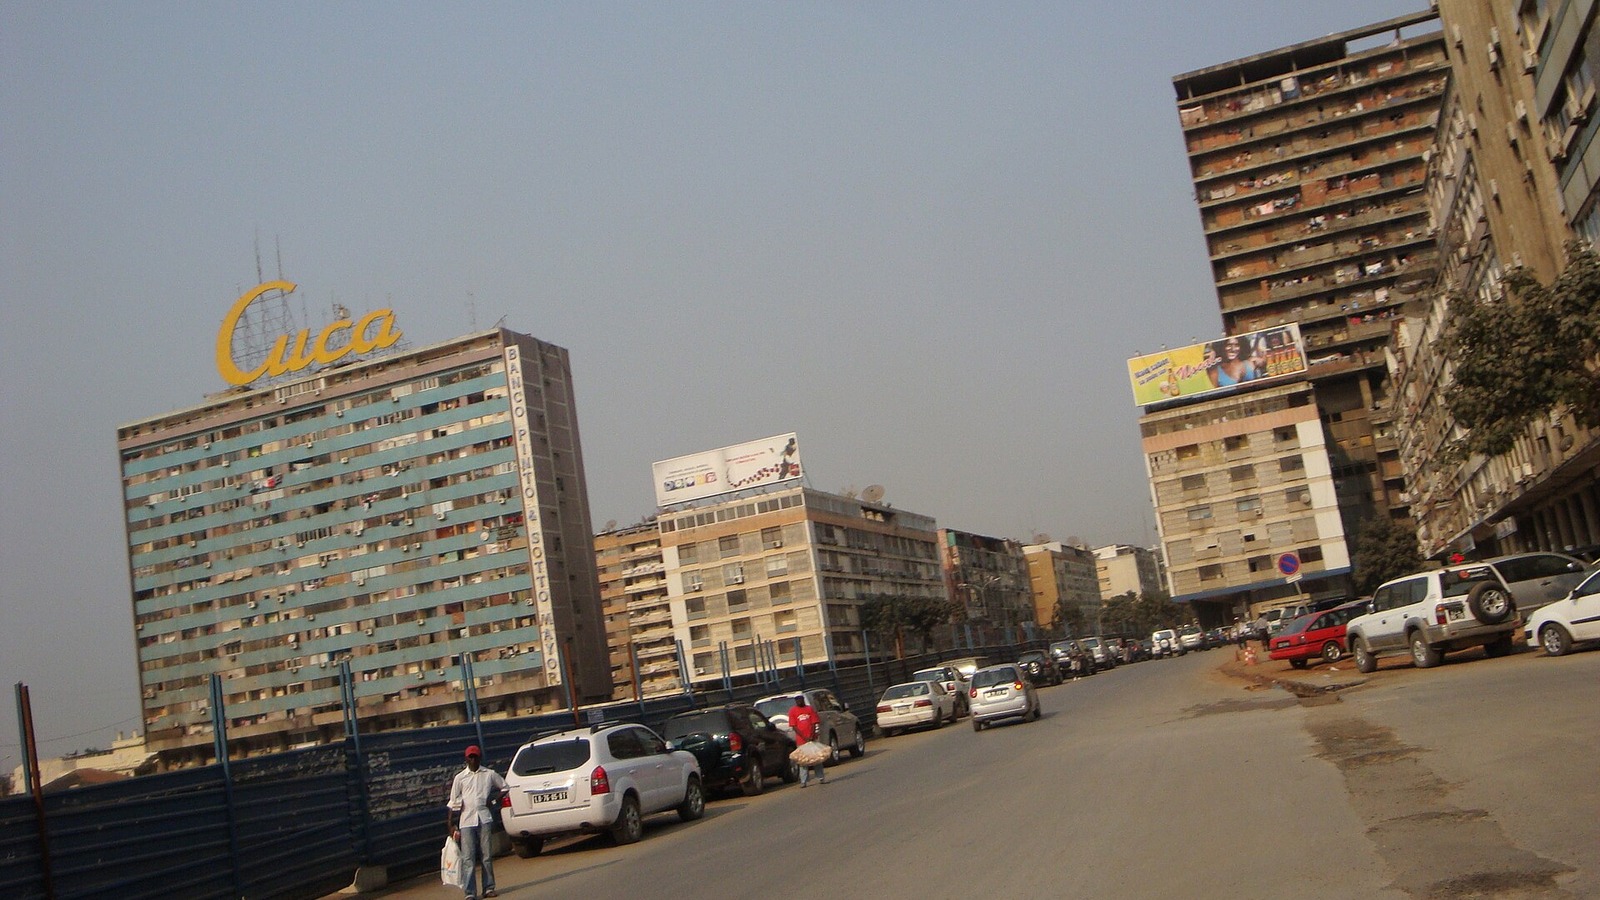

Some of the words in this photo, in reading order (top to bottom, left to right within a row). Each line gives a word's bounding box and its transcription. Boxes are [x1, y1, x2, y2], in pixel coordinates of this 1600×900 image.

[216, 280, 403, 386] Cuca
[508, 349, 525, 418] BANCO
[518, 429, 535, 498] PINTO
[531, 533, 549, 603] SOTTO
[540, 614, 560, 686] MAYOR
